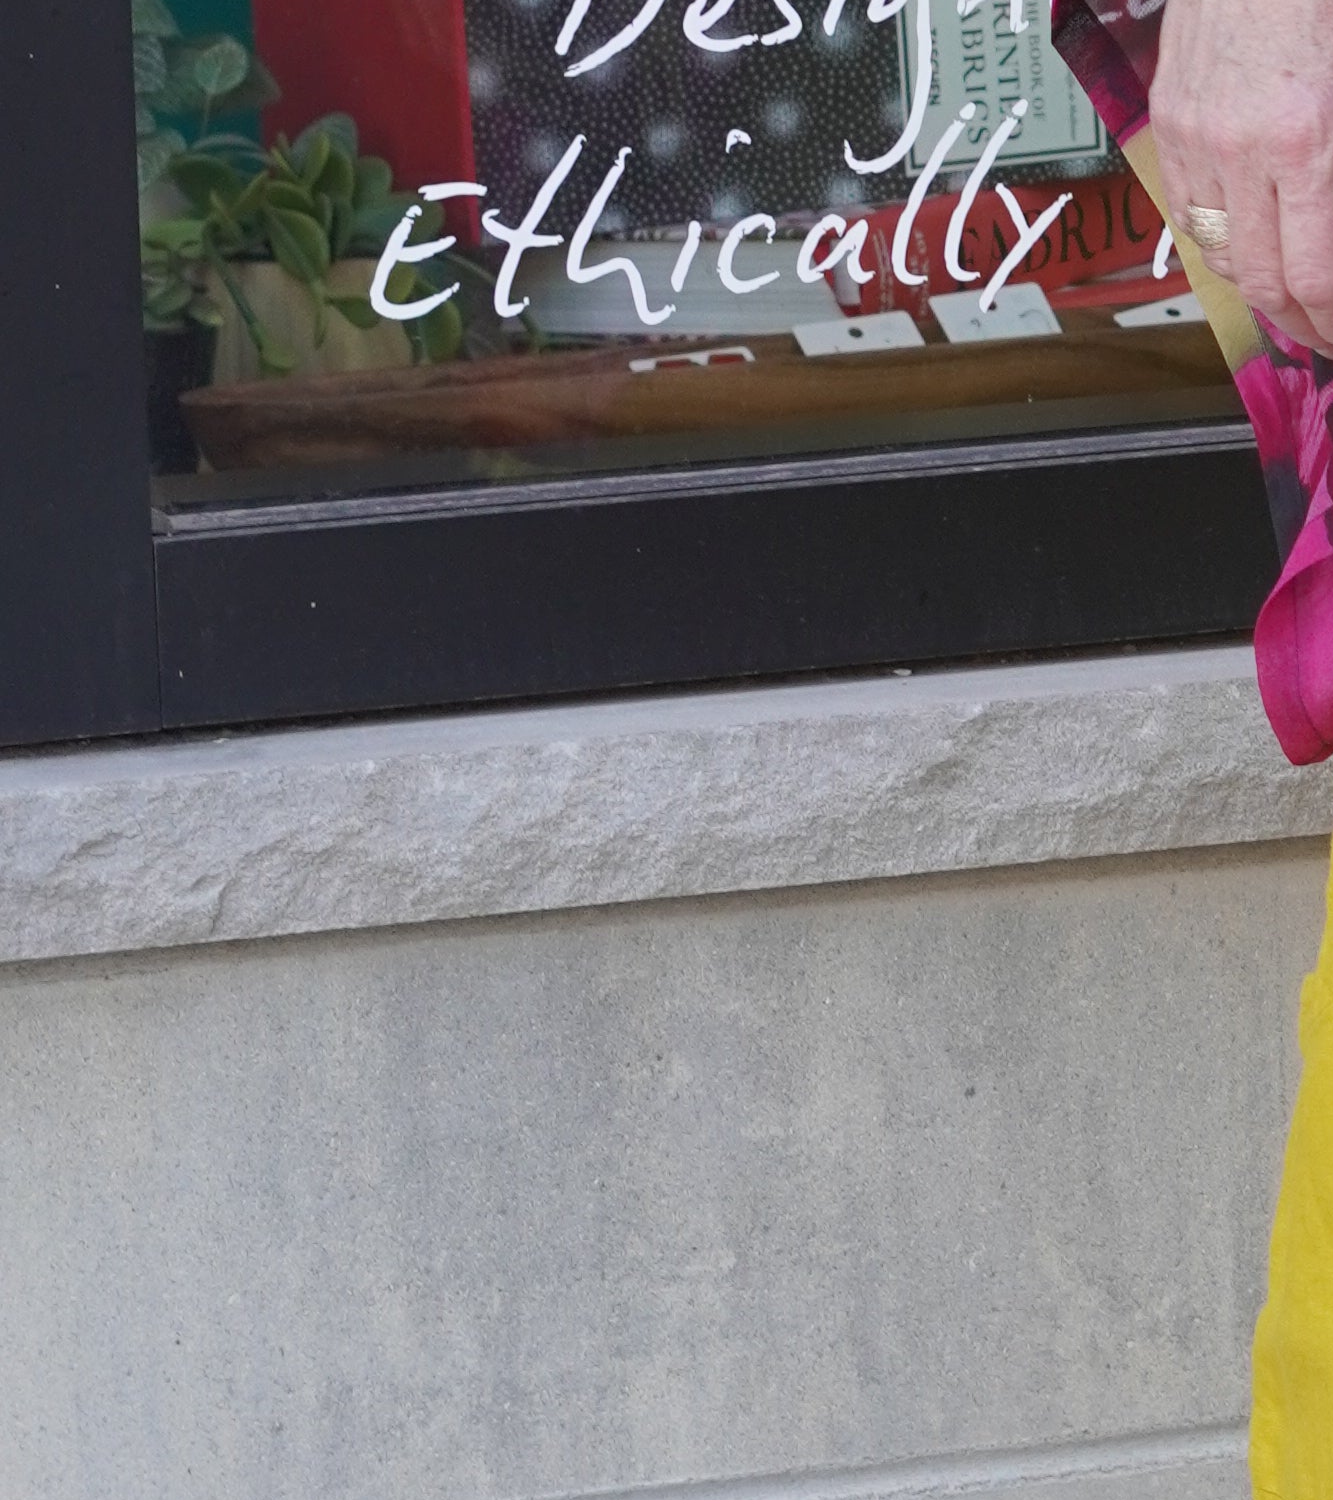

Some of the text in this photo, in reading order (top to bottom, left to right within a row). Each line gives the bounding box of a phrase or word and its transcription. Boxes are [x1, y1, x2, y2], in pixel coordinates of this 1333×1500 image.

[1029, 35, 1044, 92] BOOK
[1032, 96, 1047, 121] OF
[369, 98, 1073, 325] Ethically
